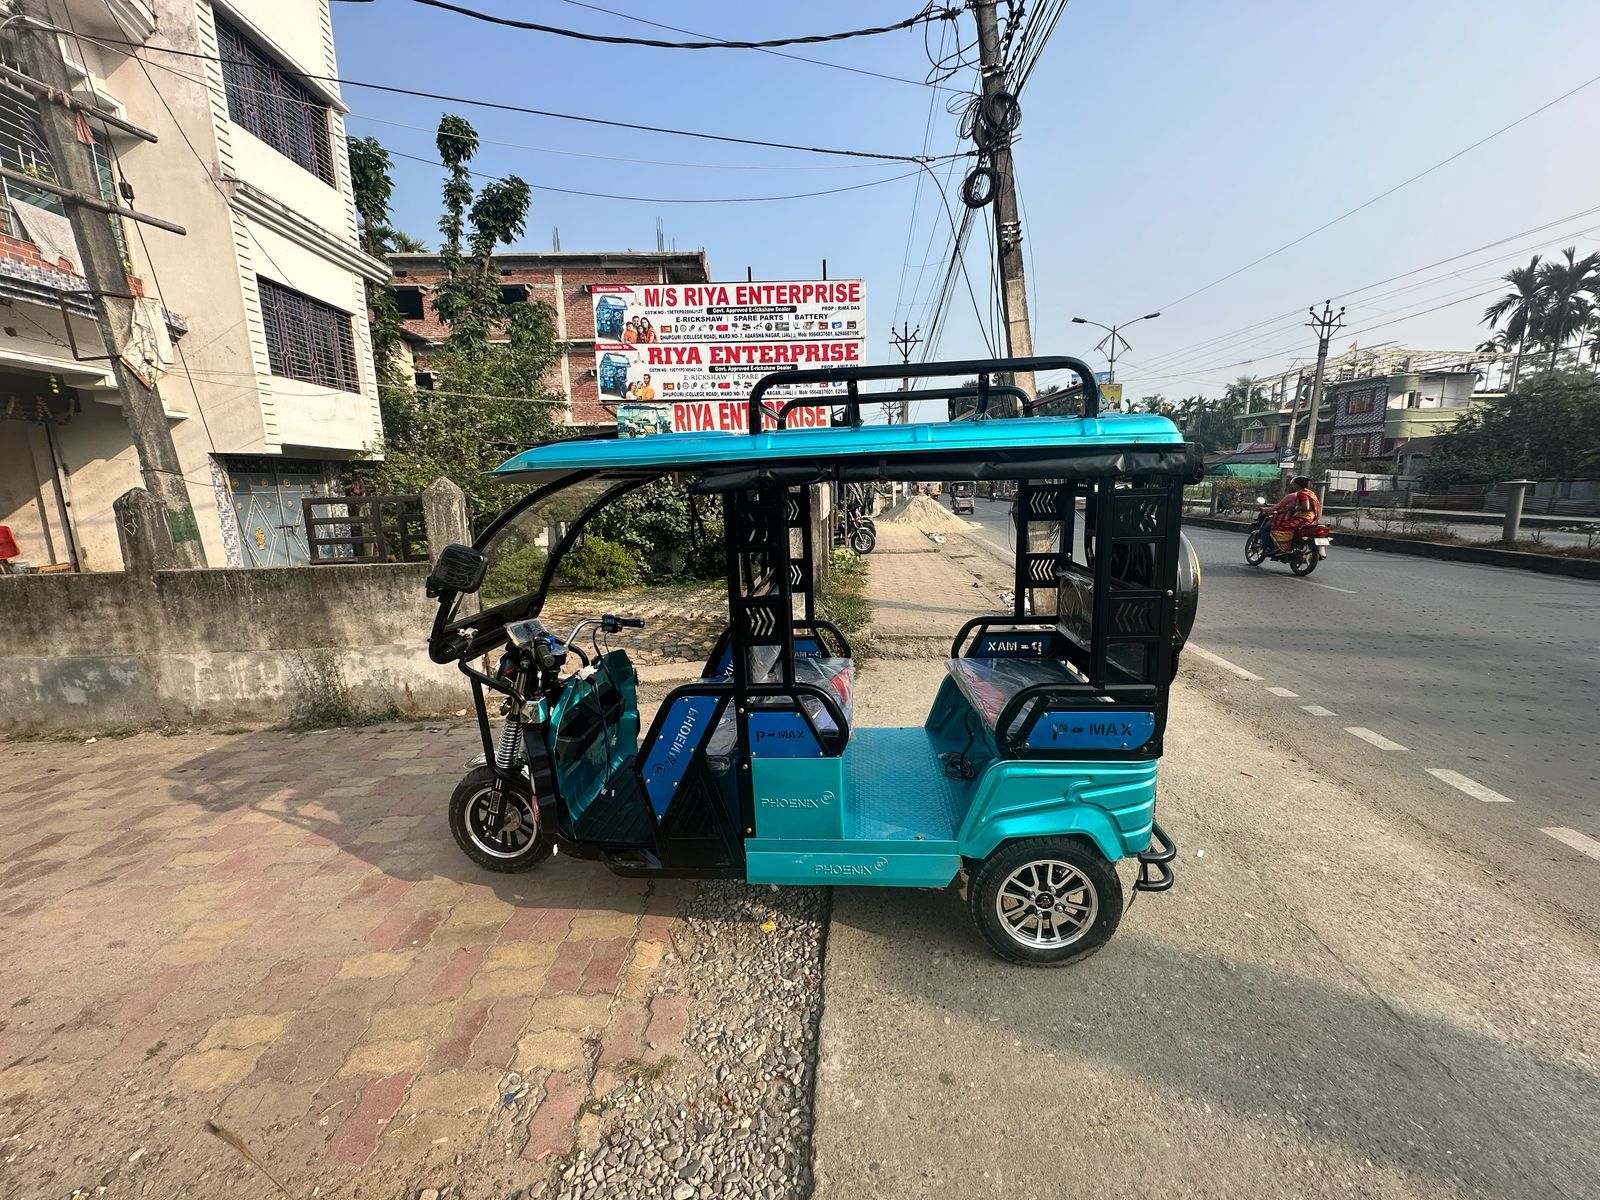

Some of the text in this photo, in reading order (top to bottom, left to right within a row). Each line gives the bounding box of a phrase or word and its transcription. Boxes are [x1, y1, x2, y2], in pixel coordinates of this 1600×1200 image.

[644, 283, 860, 307] M/S RIYA ENTERPRISE
[647, 343, 859, 365] RIYA ENTERPRISE
[673, 401, 827, 431] RIYA ENTRPRISE
[761, 798, 819, 809] PHOENIX
[814, 863, 872, 875] PHOENIX
